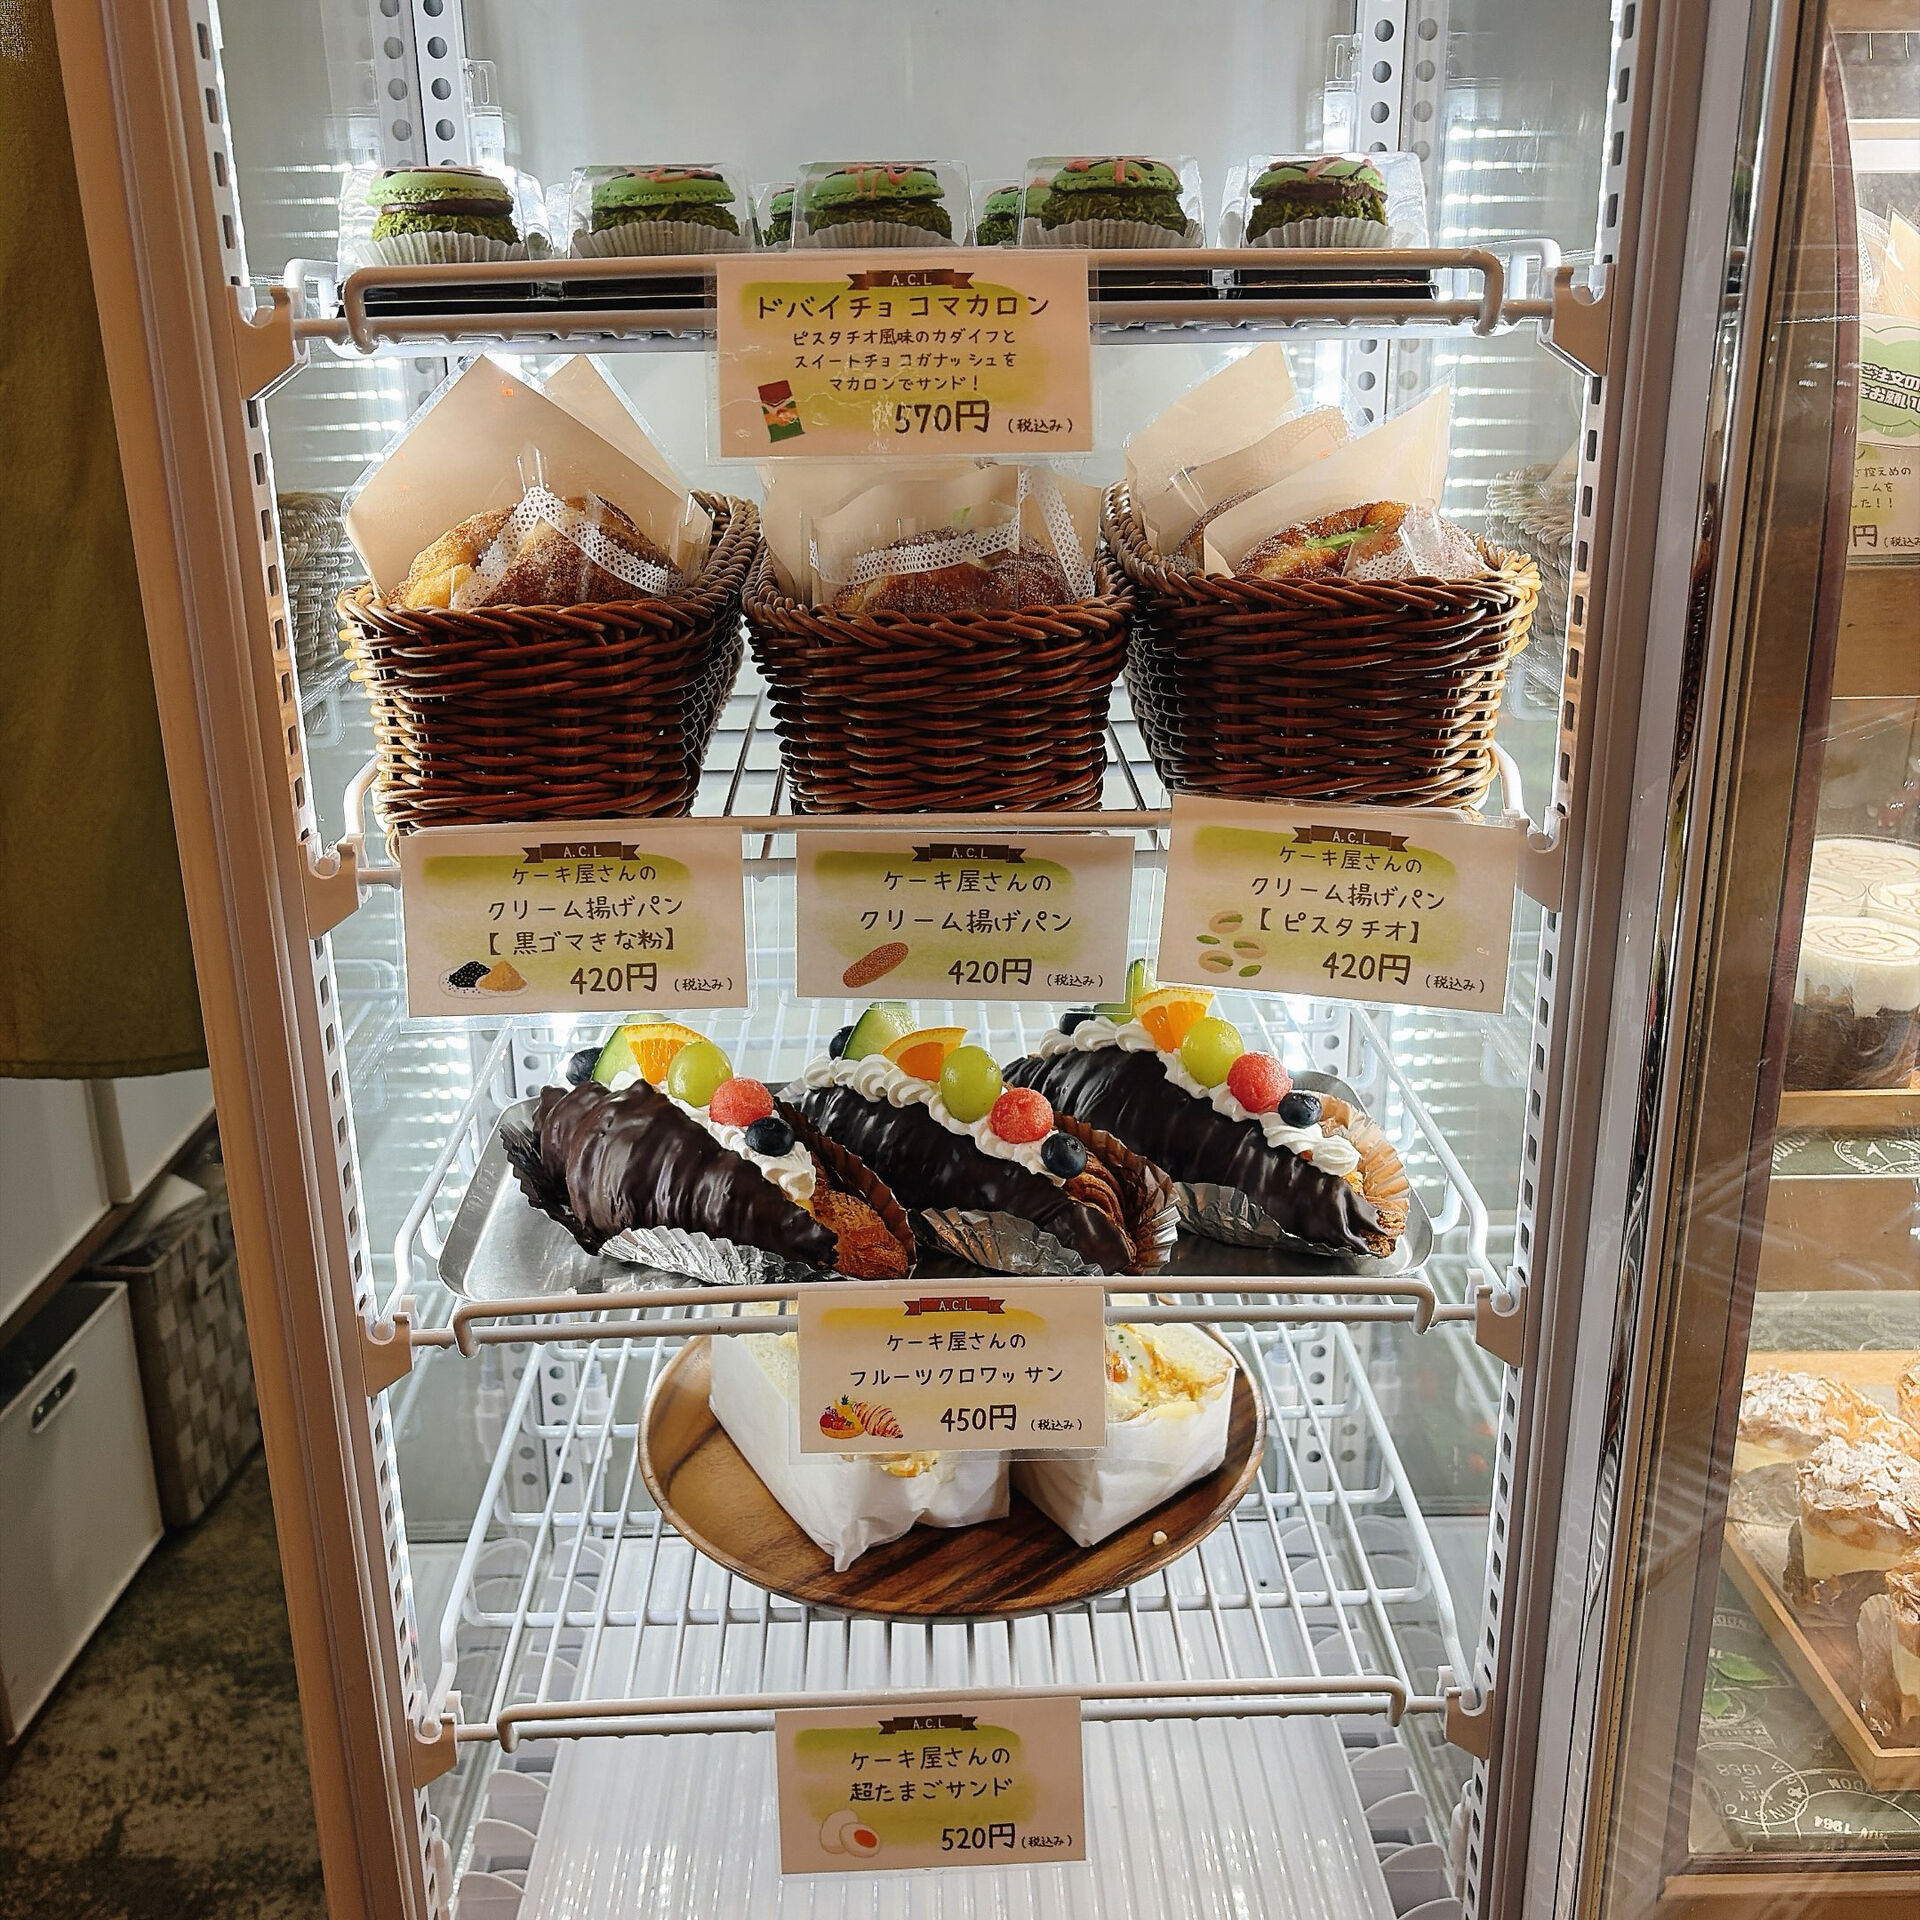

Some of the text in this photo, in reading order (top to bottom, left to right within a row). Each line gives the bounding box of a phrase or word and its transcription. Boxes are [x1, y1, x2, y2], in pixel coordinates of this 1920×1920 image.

[891, 274, 932, 287] A.C.L
[758, 296, 1049, 320] ドバイチョコマカロン
[793, 328, 1016, 347] ピスタチオ風味のカダイフと
[795, 352, 1017, 369] スイートチョコガナッシュを
[895, 400, 990, 433] 570円
[1332, 830, 1371, 846] A.C.L
[563, 844, 602, 858] A.C.L
[951, 846, 988, 860] A.C.L
[1279, 846, 1423, 875] ケーキ屋さんの
[512, 863, 656, 885] ケーキ屋さんの
[883, 869, 1052, 893] ケーキ屋さんの
[1251, 877, 1446, 911] クリーム揚げパン
[488, 895, 684, 921] クリーム揚げパン
[860, 909, 1073, 934] クリーム揚げパン
[570, 962, 658, 994] 420円
[948, 958, 1033, 986] 420円
[1322, 951, 1412, 986] 420円
[938, 1299, 973, 1312] A.C.L
[887, 1331, 1027, 1352] ケーキ屋さんの
[850, 1366, 1064, 1387] フルーツクロワッサン
[940, 1404, 1018, 1433] 450円
[912, 1718, 946, 1730] A.C.L
[850, 1746, 1011, 1771] ケーキ屋さんの
[849, 1777, 1014, 1802] 超たまごサンド
[940, 1822, 1016, 1851] 520円
